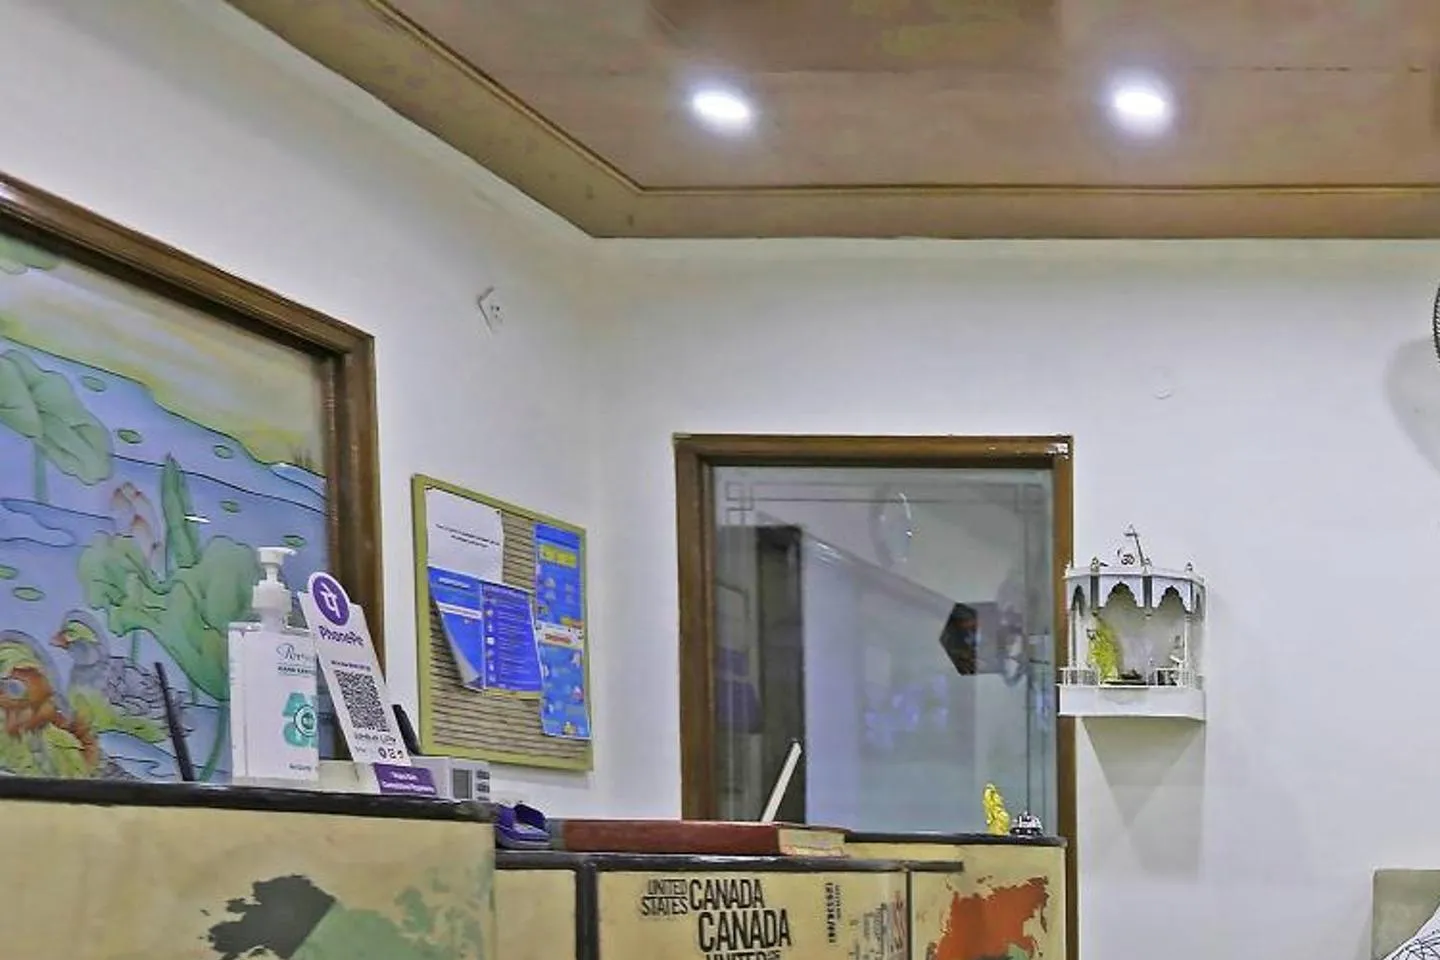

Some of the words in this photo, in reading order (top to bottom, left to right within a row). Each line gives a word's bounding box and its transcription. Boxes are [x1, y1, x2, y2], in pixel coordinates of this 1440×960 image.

[647, 878, 689, 896] UNITED
[689, 878, 766, 911] CANADA
[641, 895, 689, 916] STATES
[698, 908, 793, 952] CANADA
